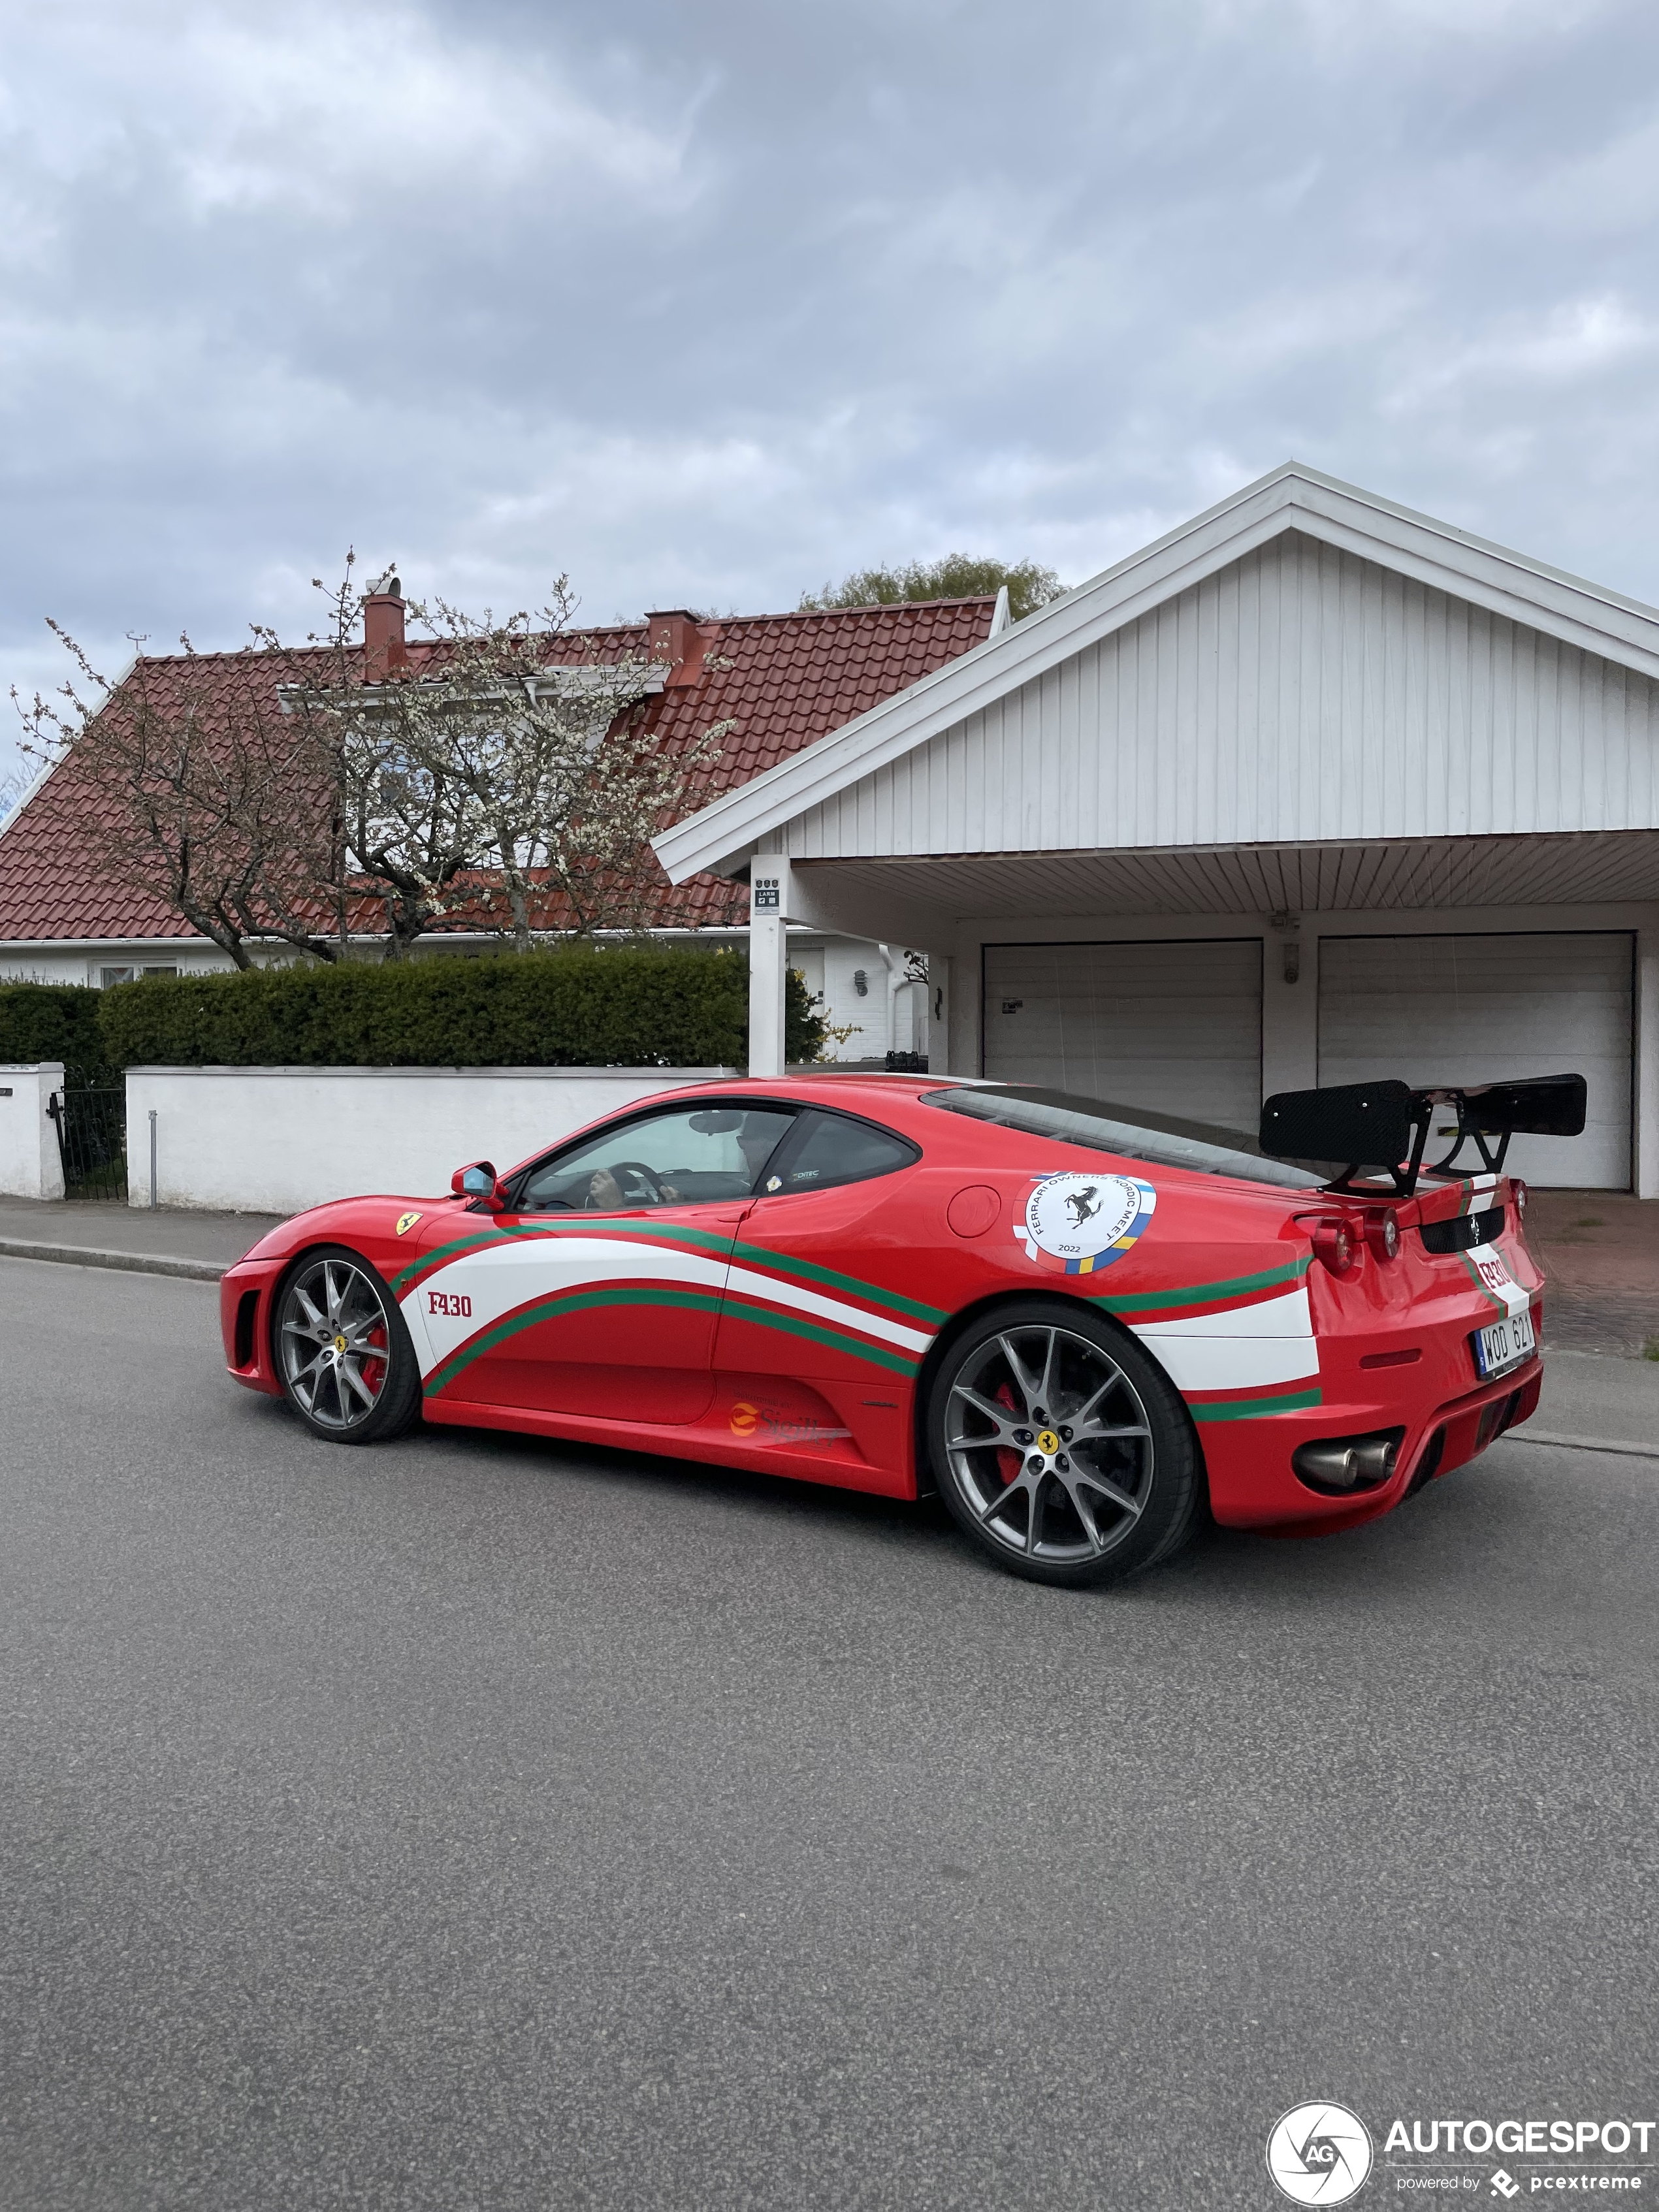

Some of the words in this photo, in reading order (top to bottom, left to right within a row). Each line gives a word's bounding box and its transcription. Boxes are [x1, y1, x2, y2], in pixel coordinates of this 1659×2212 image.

[1113, 1179, 1135, 1207] NORDIC
[1031, 1186, 1048, 1235] FERRARI
[1106, 1210, 1133, 1241] MEET
[1058, 1244, 1080, 1253] 2022
[1478, 1259, 1511, 1289] F430
[428, 1292, 472, 1317] F430
[1483, 1326, 1507, 1366] WOD
[1512, 1313, 1532, 1350] 621
